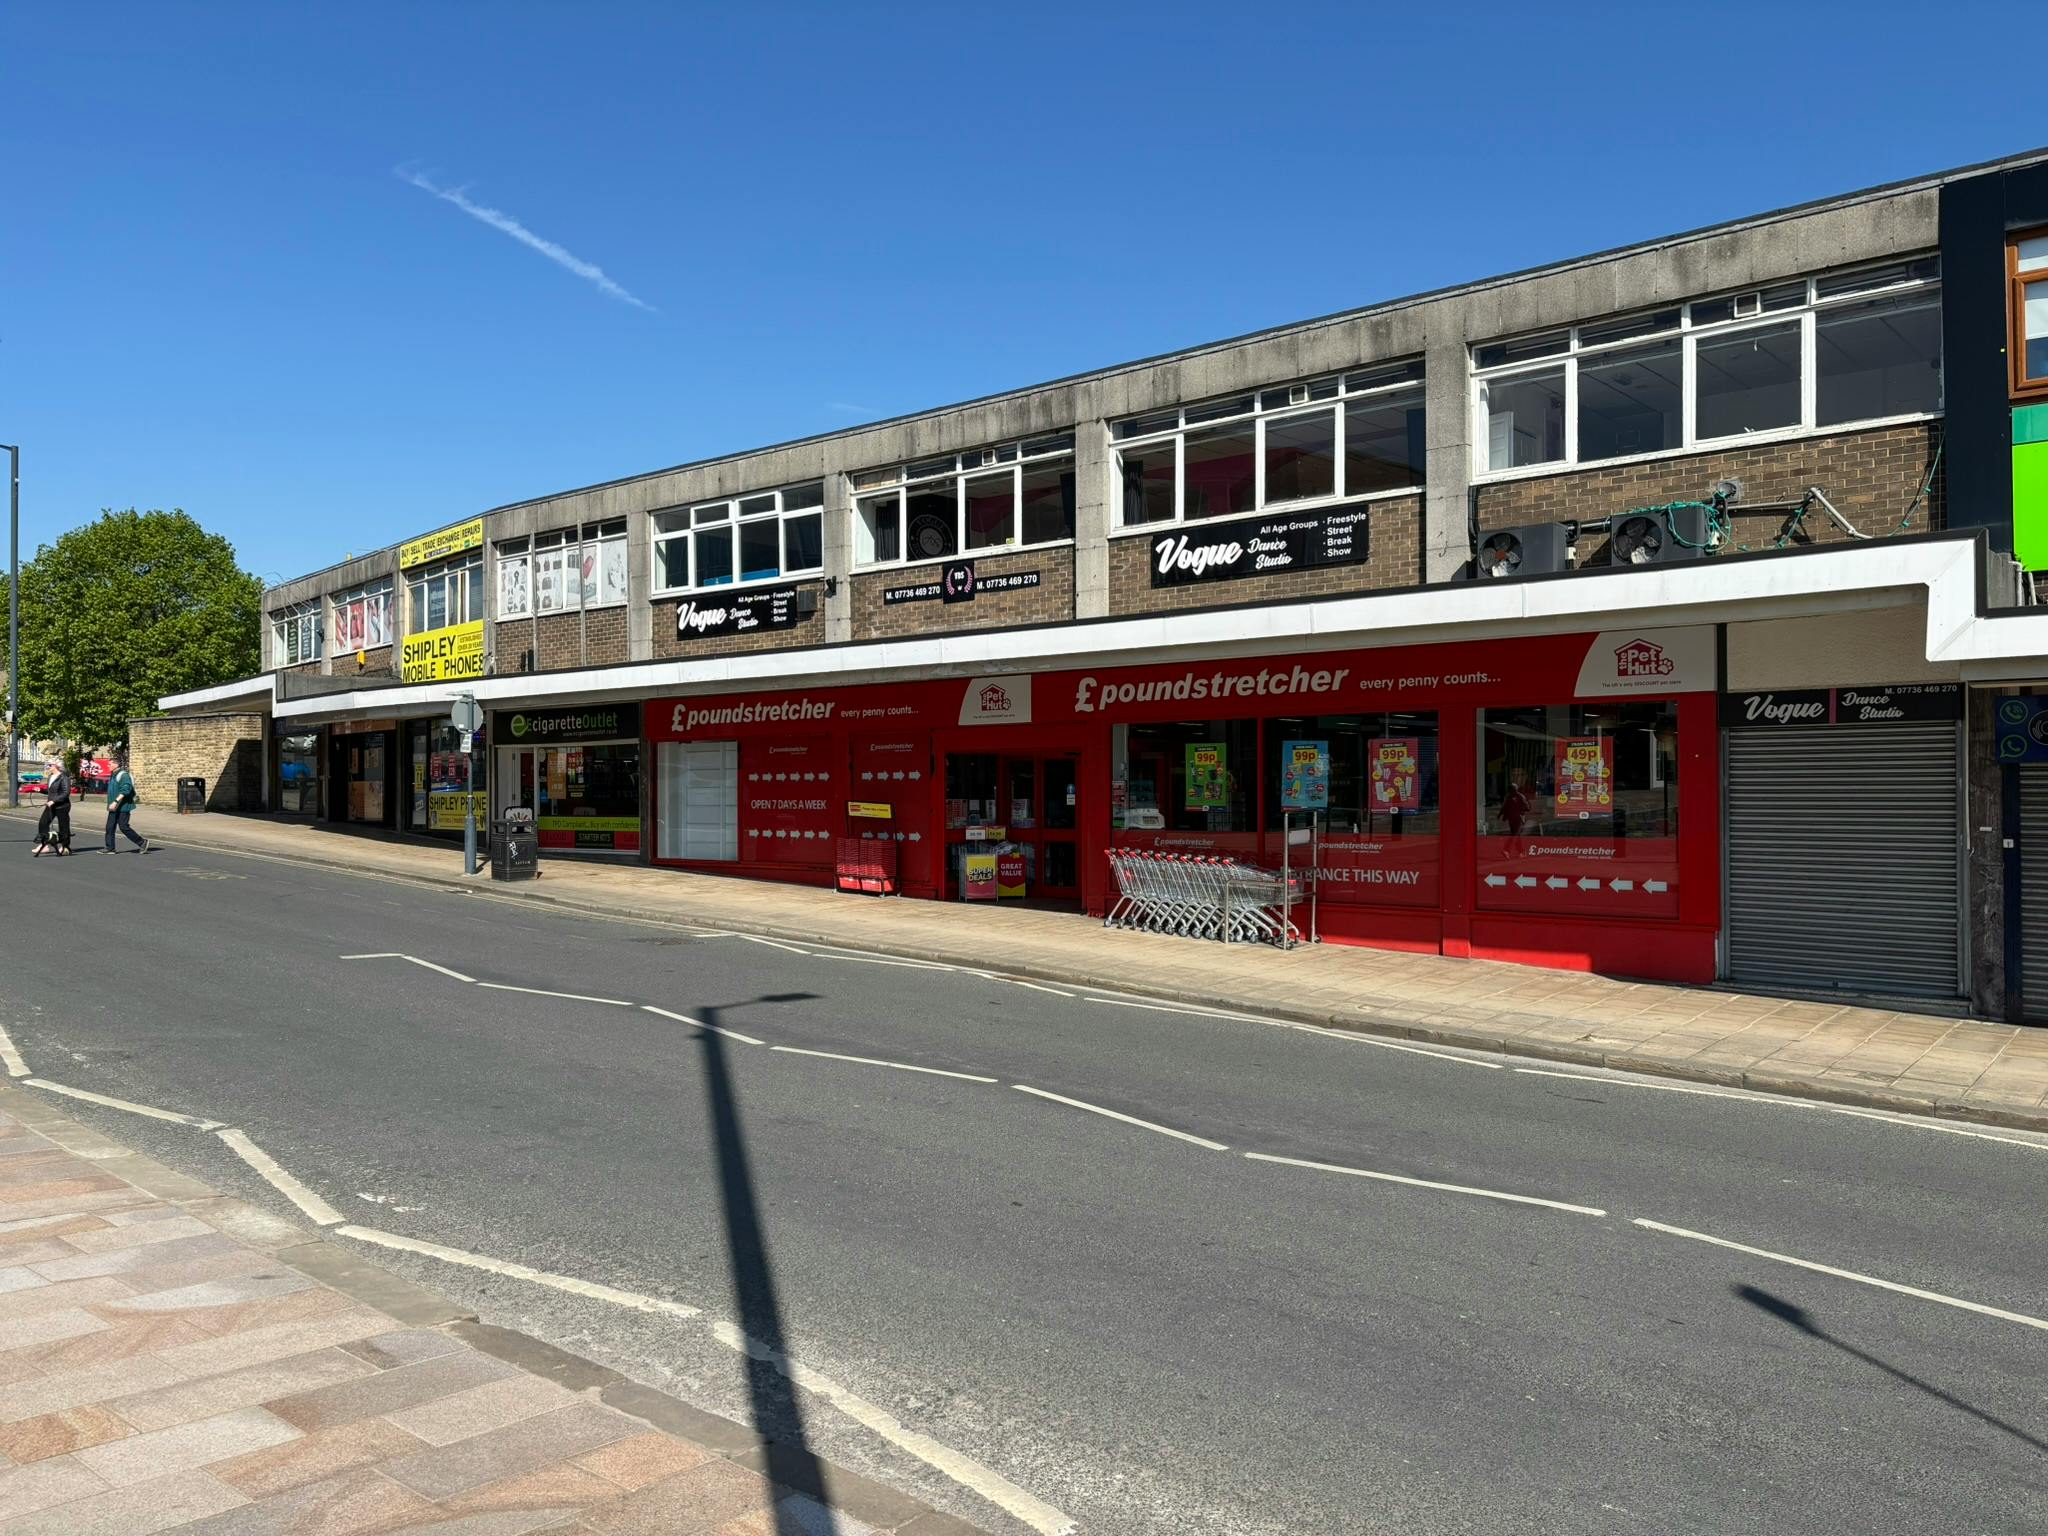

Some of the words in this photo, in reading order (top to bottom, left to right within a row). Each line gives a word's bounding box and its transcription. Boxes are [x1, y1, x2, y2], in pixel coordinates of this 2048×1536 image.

[1327, 512, 1366, 525] Freestyle
[1260, 526, 1270, 535] All
[1272, 524, 1288, 534] Age
[1289, 520, 1318, 532] Groups
[1327, 525, 1353, 535] Street
[1247, 537, 1288, 554] Dance
[1327, 536, 1352, 547] Break
[1155, 535, 1243, 576] Vogue
[1327, 547, 1352, 557] Show
[1255, 554, 1293, 570] Studio
[986, 578, 1008, 589] 07736
[1008, 576, 1022, 585] 469
[1023, 574, 1038, 584] 270
[928, 585, 941, 595] 270
[677, 601, 727, 632] Vogue
[403, 635, 456, 664] SHIPLEY
[1627, 649, 1657, 663] Pet
[1618, 652, 1627, 669] the
[403, 662, 436, 682] MOBILE
[444, 653, 483, 677] PHONES
[1627, 662, 1658, 675] Hut
[1359, 677, 1395, 691] every
[1398, 674, 1440, 690] penny
[986, 690, 1003, 701] Pet
[1885, 687, 1895, 695] M.
[1897, 686, 1922, 695] 07736
[1924, 685, 1940, 693] 469
[986, 700, 1003, 710] Hut
[1841, 692, 1890, 706] Dance
[840, 710, 860, 719] every
[862, 708, 885, 719] penny
[1743, 694, 1825, 724] Vogue
[1859, 705, 1904, 720] Studio
[1196, 752, 1216, 764] 99p
[1295, 750, 1316, 762] 99p
[1382, 749, 1405, 760] 99p
[1571, 748, 1597, 761] 49p
[430, 797, 460, 811] SHIPLEY
[751, 799, 771, 809] OPEN
[772, 800, 777, 808] 7
[778, 800, 797, 809] DAYS
[798, 800, 804, 809] A
[804, 800, 827, 810] WEEK
[969, 866, 993, 875] SUPER
[1352, 868, 1384, 883] THIS
[1385, 870, 1420, 885] WAY
[968, 873, 993, 882] DEALS
